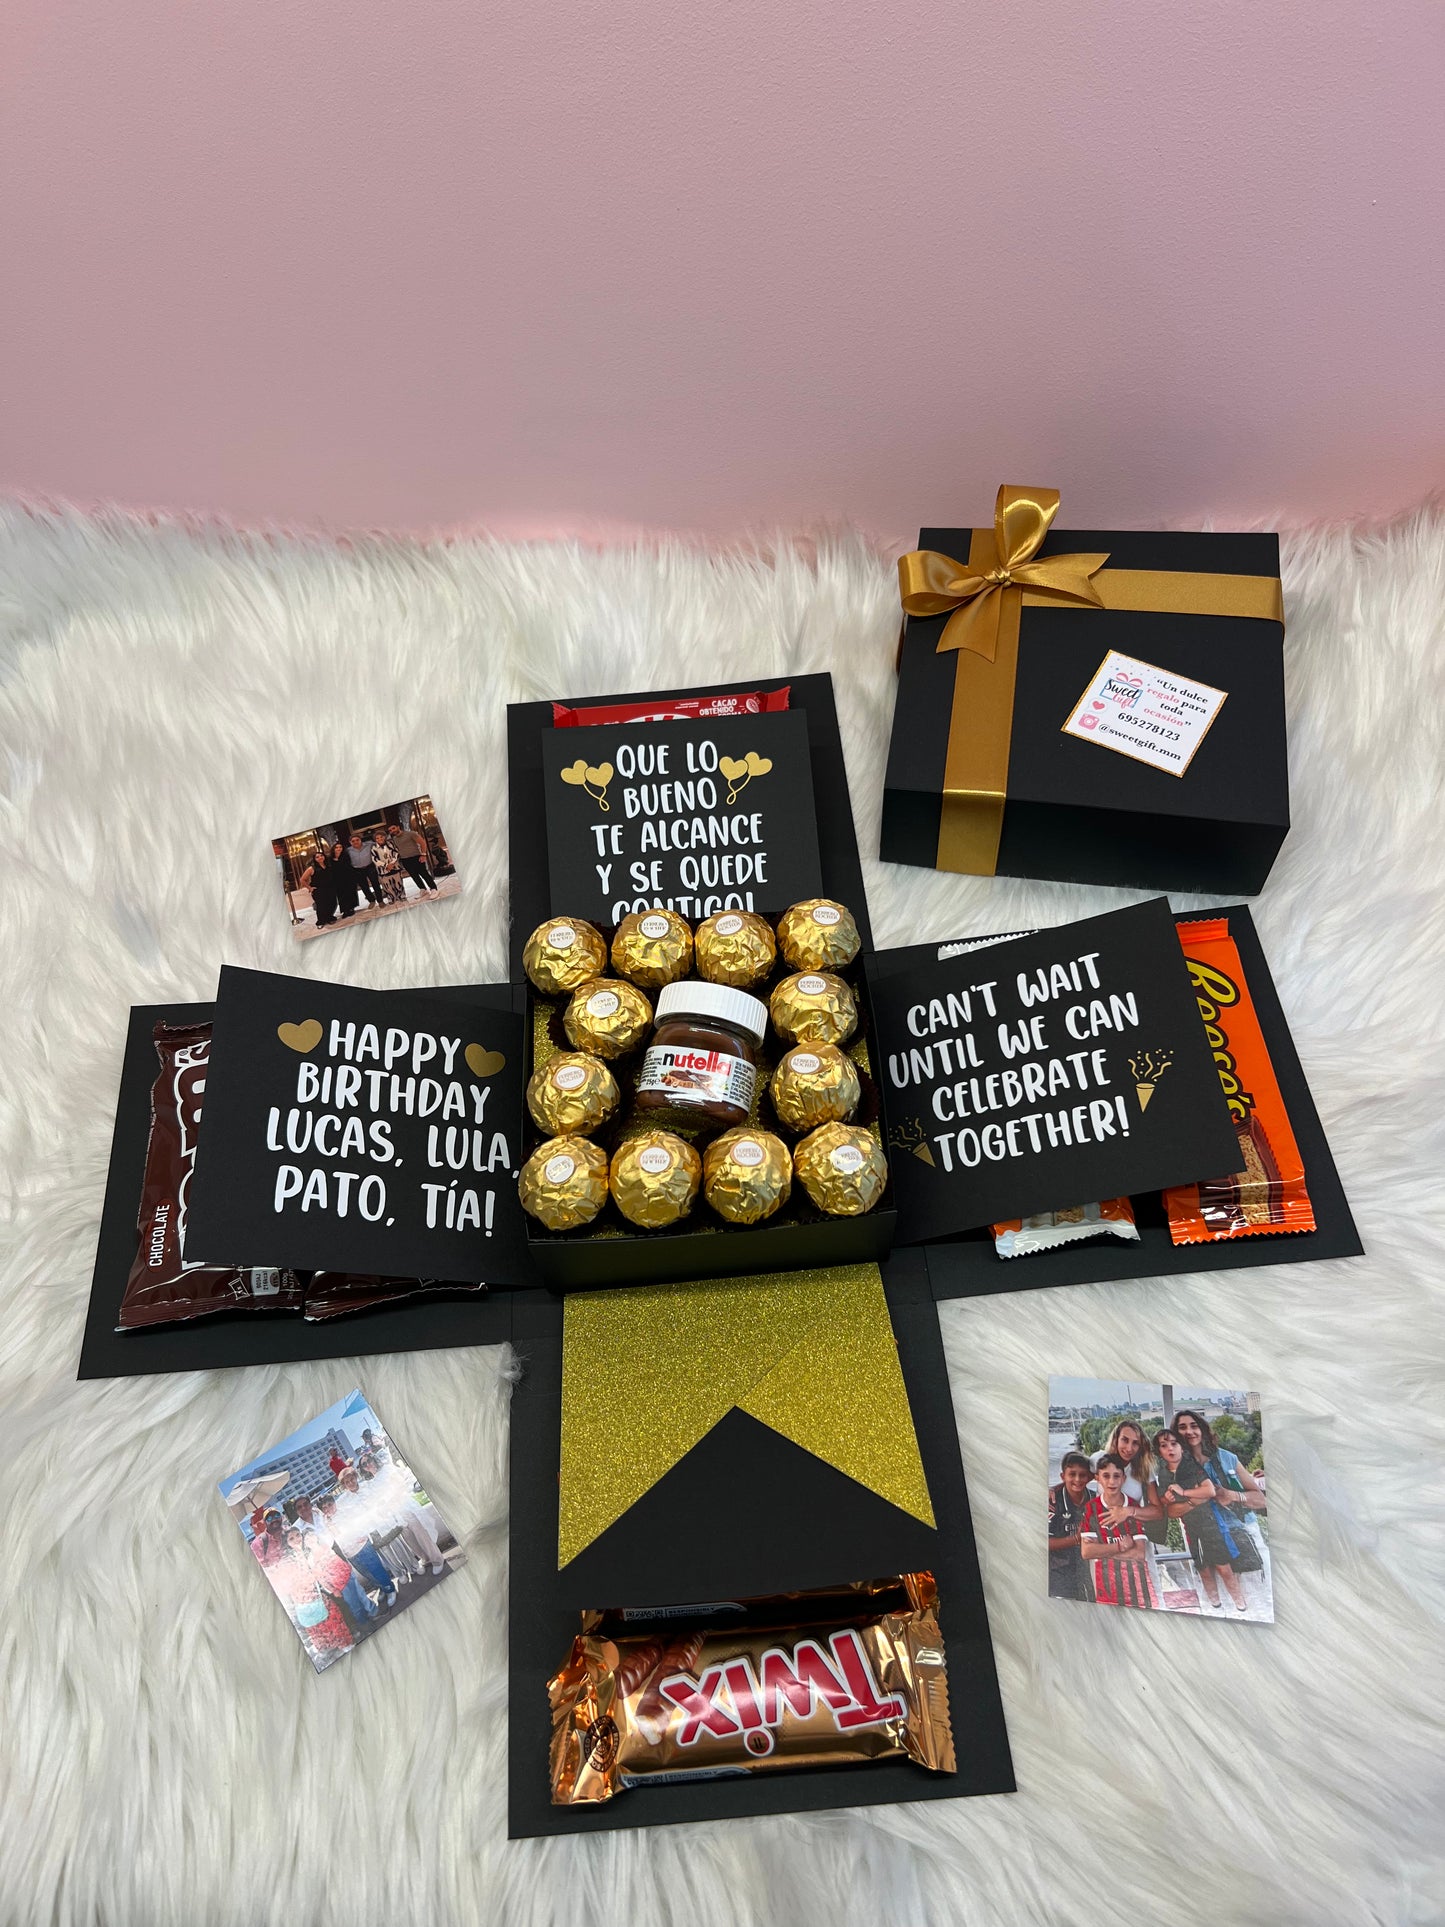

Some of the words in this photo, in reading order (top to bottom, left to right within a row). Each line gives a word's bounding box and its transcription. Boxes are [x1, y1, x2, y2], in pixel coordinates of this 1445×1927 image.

[712, 699, 738, 708] CACAO
[1104, 679, 1140, 700] Sweet
[1146, 687, 1180, 704] regalo
[1180, 701, 1207, 716] para
[1160, 702, 1184, 717] toda
[1179, 689, 1209, 705] dulce
[699, 706, 734, 717] OBTENIDO
[1118, 712, 1181, 742] 695278123
[616, 744, 670, 780] QUE
[686, 740, 719, 774] LO
[1099, 723, 1182, 762] @sweetgift.mm
[623, 777, 718, 819] BUENO
[590, 824, 624, 857] TE
[640, 813, 764, 853] ALCANCE
[595, 863, 613, 896] Y
[629, 860, 664, 893] SE
[679, 852, 768, 892] QUEDE
[907, 981, 998, 1037] CAN'T
[1016, 952, 1101, 1008] WAIT
[328, 1019, 462, 1075] HAPPY
[889, 1033, 985, 1088] UNTIL
[997, 1015, 1050, 1060] WE
[1065, 991, 1139, 1040] CAN
[662, 1050, 731, 1076] nutella
[296, 1061, 491, 1125] BIRTHDAY
[932, 1048, 1111, 1122] CELEBRATE
[266, 1106, 404, 1168] LUCAS,
[427, 1124, 520, 1179] LULA,
[933, 1095, 1130, 1173] TOGETHER!
[274, 1164, 395, 1227] PATO,
[420, 1179, 496, 1238] TÍA!
[148, 1204, 170, 1267] CHOCOLATE
